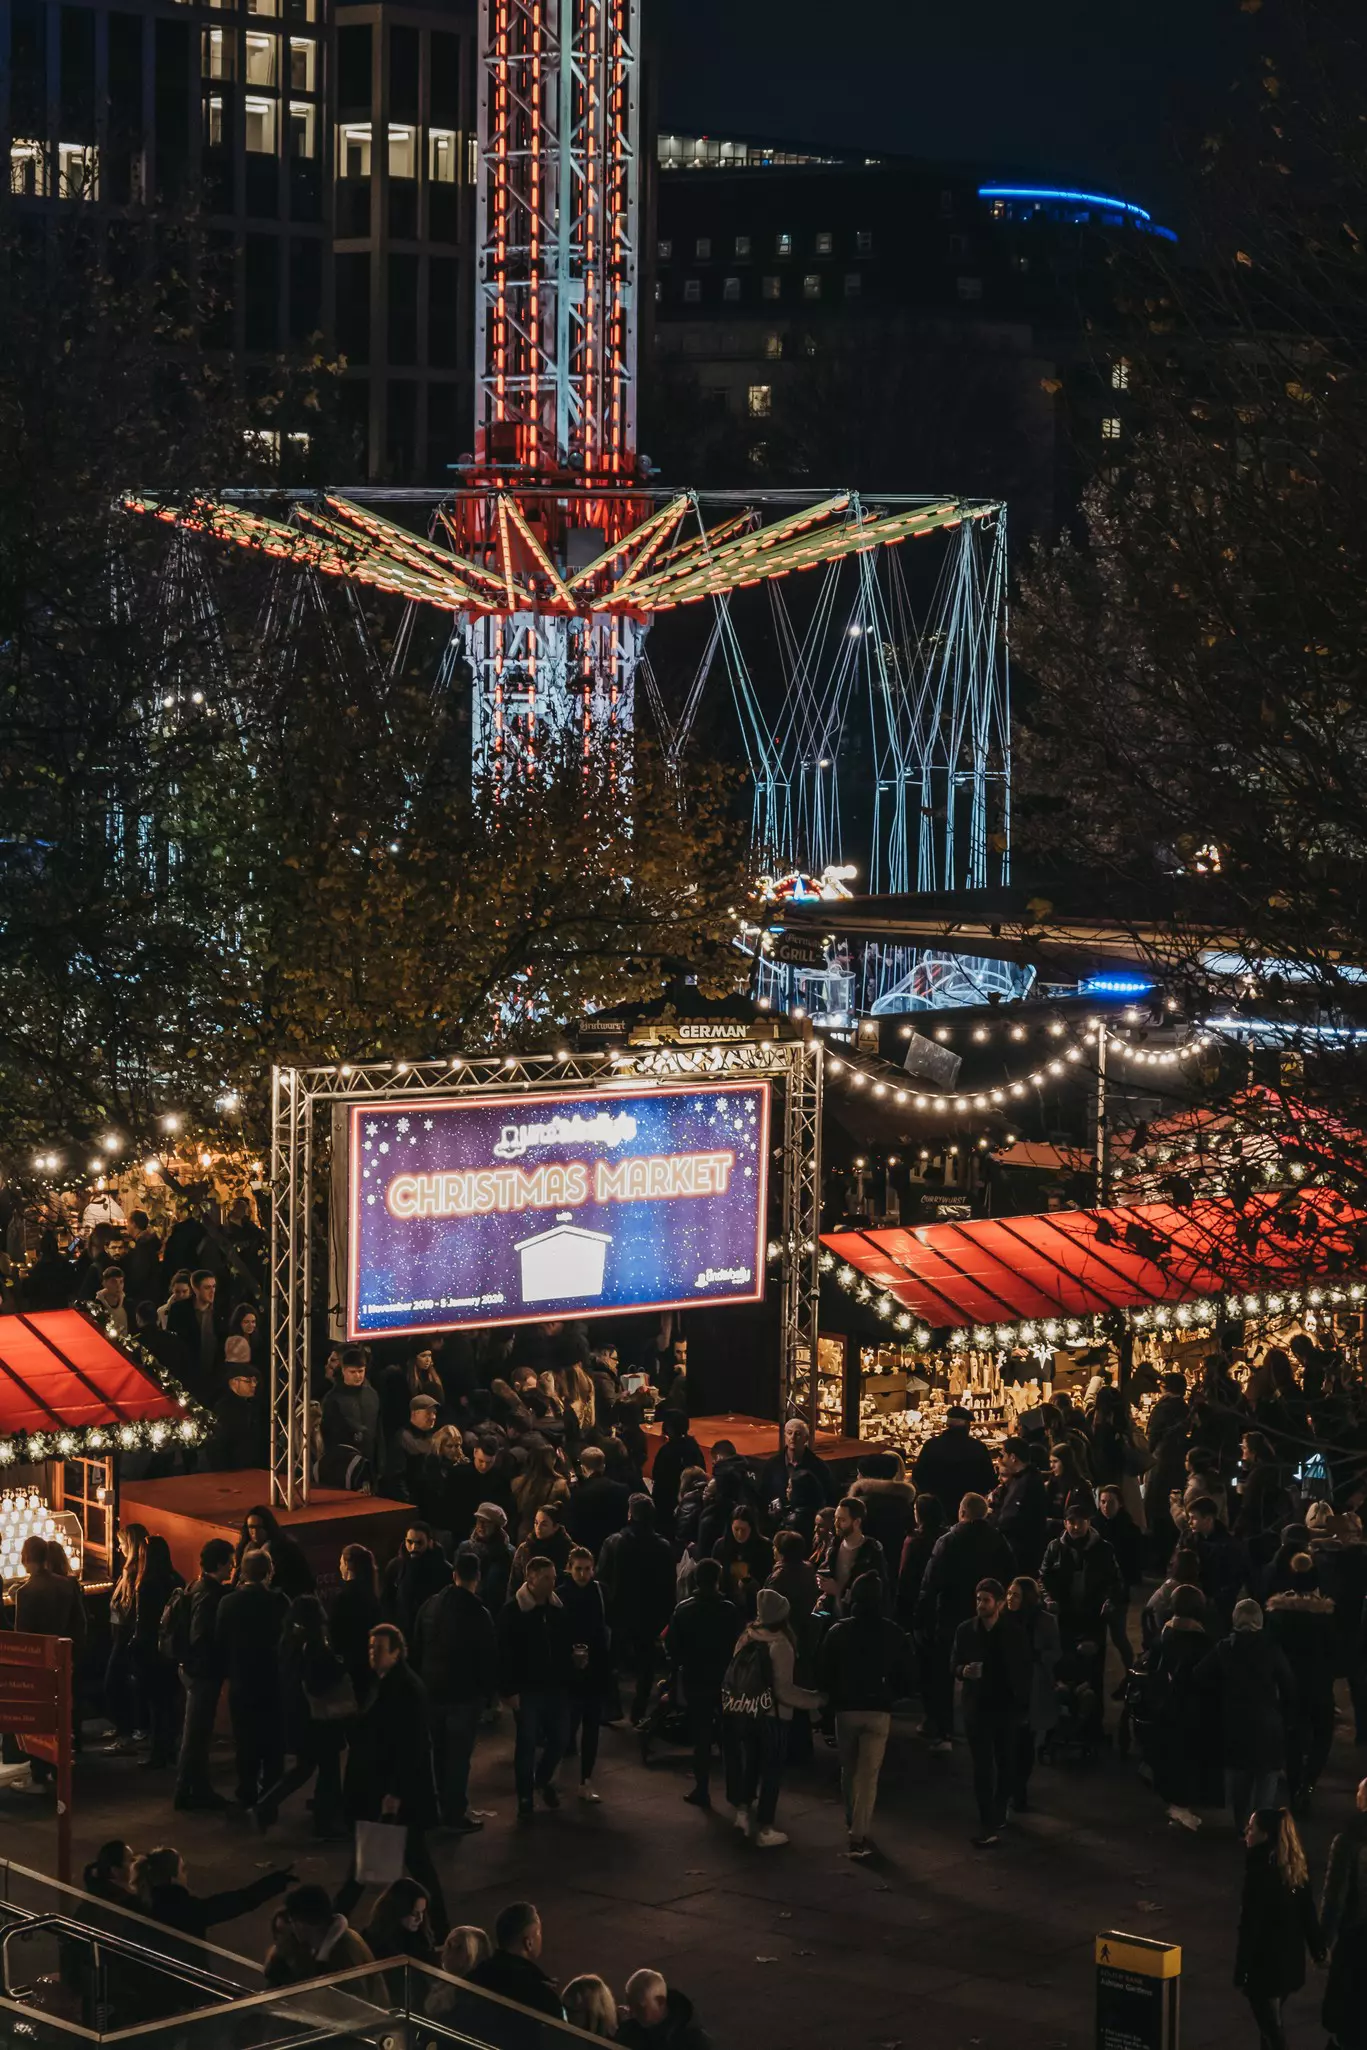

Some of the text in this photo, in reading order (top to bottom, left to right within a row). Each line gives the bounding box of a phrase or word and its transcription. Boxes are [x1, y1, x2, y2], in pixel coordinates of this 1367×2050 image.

[779, 945, 816, 963] GRILL
[679, 1025, 747, 1038] GERMAN
[389, 1153, 733, 1216] CHRISTMAS MARKET
